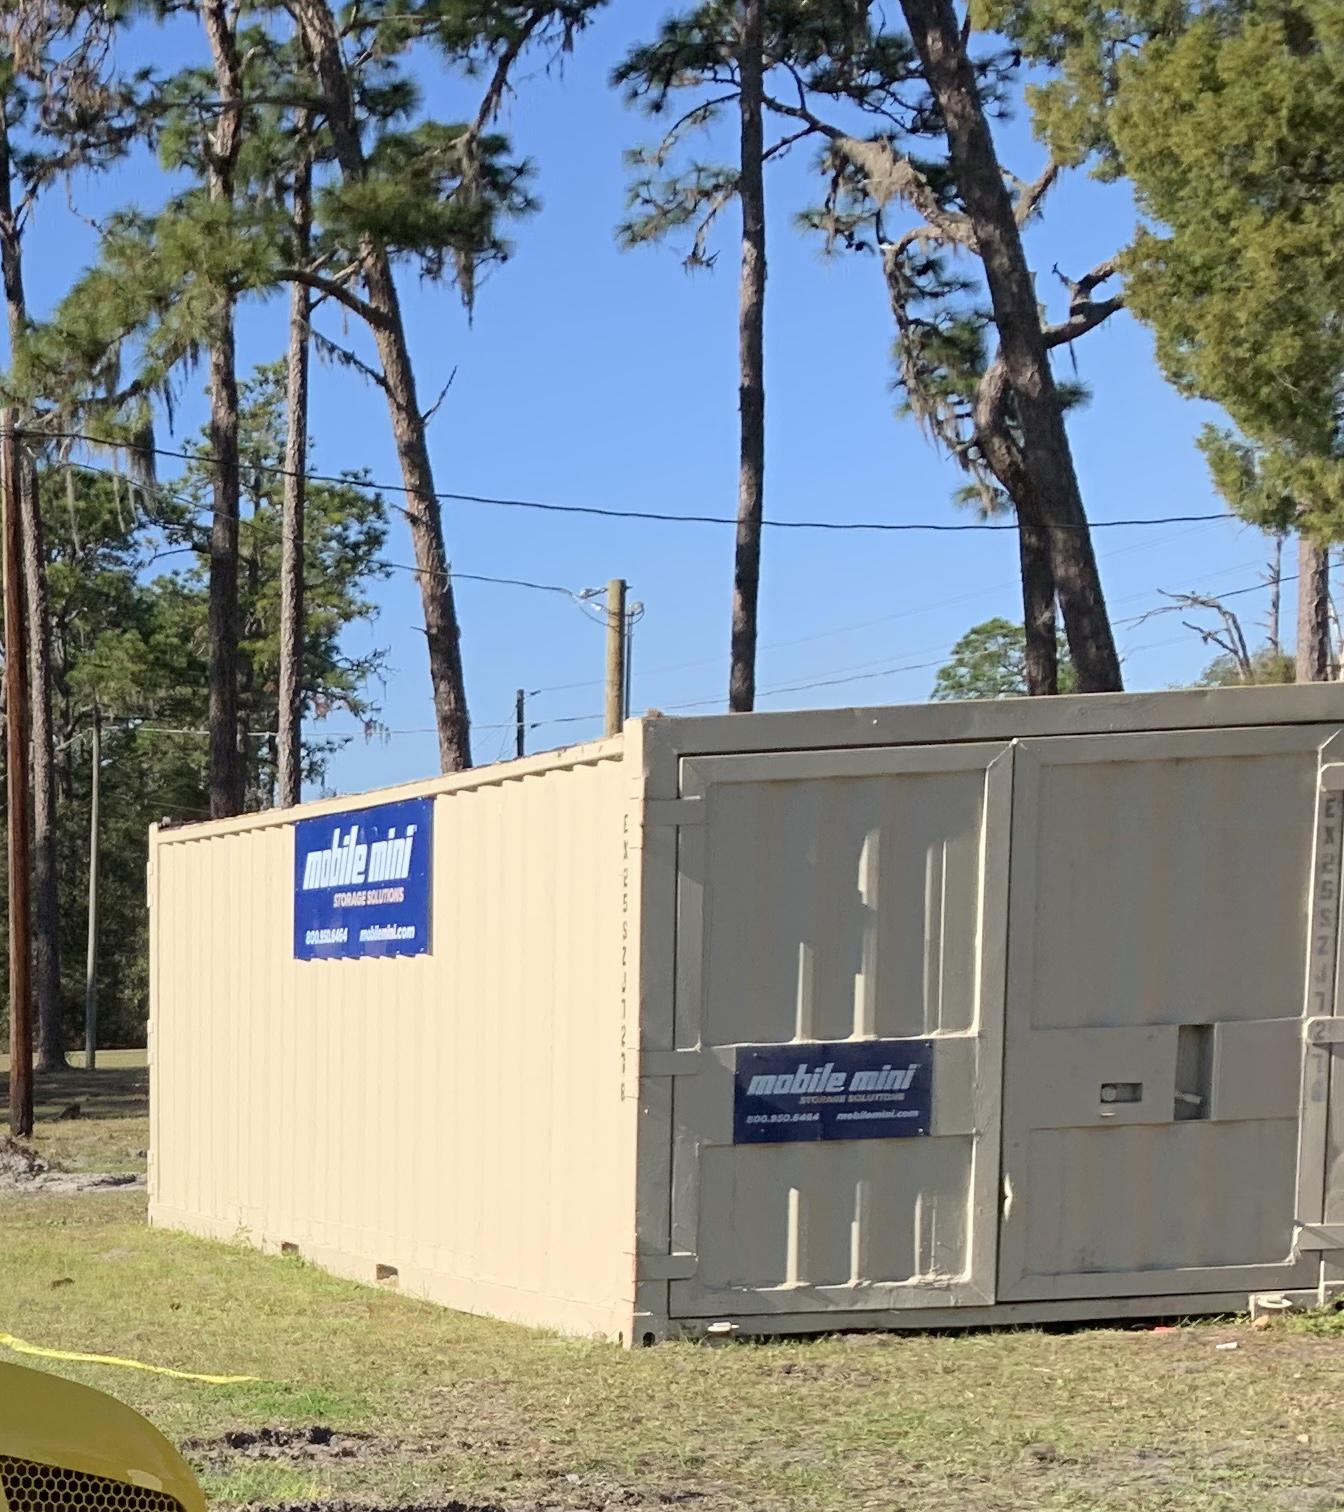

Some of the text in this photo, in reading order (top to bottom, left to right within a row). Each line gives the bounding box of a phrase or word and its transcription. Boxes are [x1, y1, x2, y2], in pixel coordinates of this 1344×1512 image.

[303, 825, 417, 890] mobile mini
[366, 887, 404, 906] SOLUTIONS
[359, 924, 415, 942] mobilemini.com
[746, 1062, 916, 1096] mobile mini
[848, 1093, 905, 1103] SOLUTIONS
[836, 1109, 920, 1121] mobilemini.com
